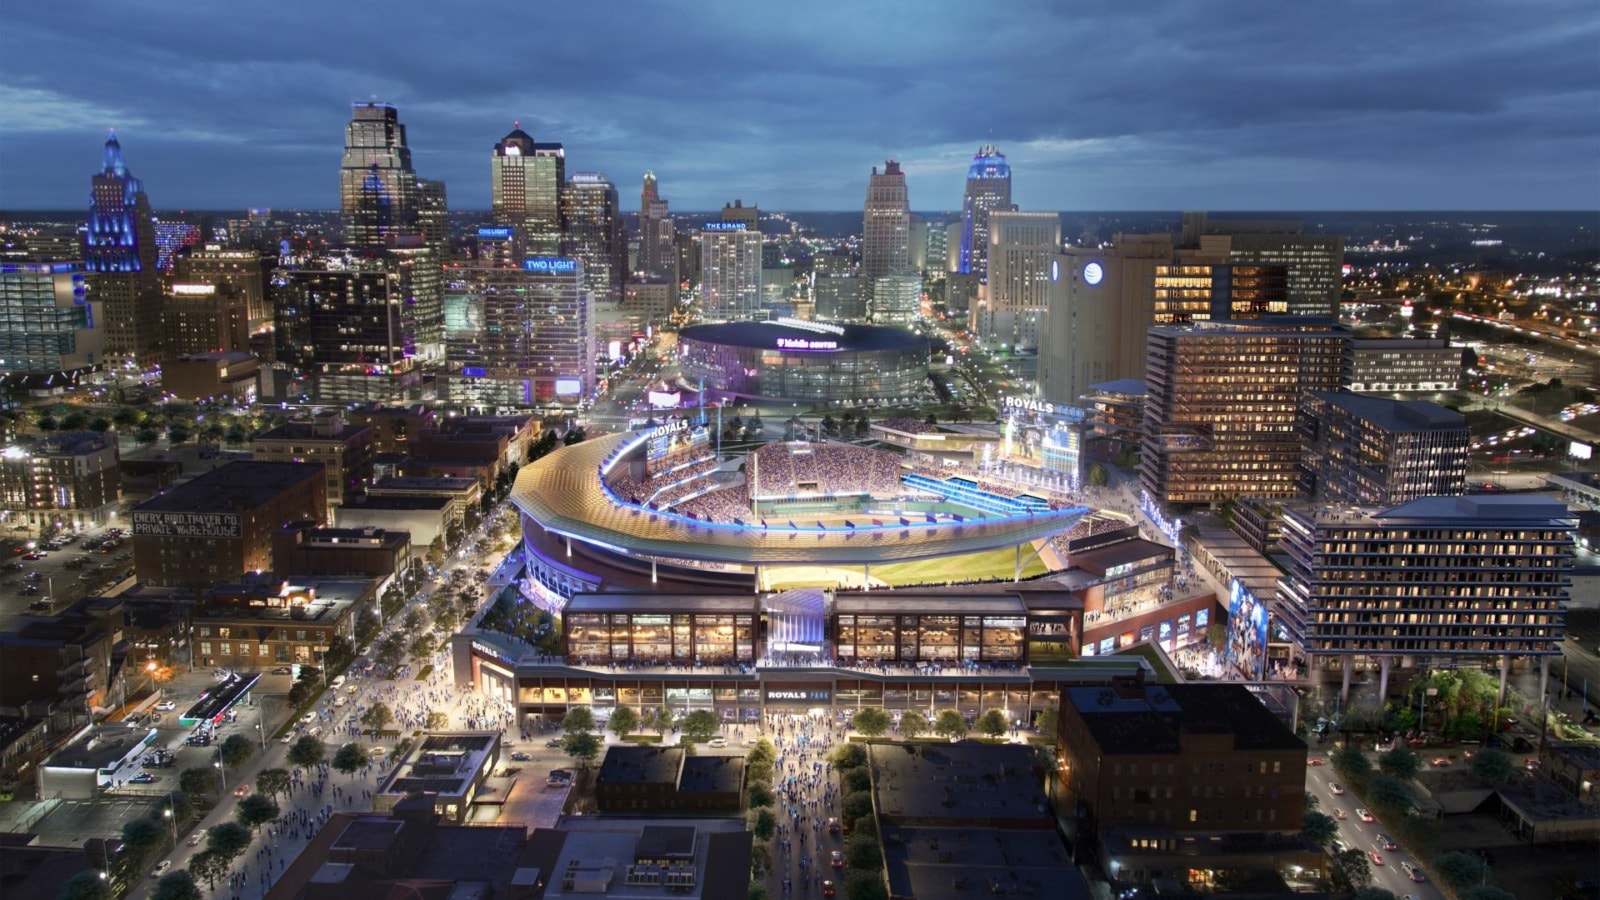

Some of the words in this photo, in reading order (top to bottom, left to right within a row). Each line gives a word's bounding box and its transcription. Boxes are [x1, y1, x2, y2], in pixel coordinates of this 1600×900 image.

[526, 260, 547, 269] TWO
[548, 260, 575, 269] LIGHT
[1006, 396, 1053, 413] ROYALS
[651, 419, 688, 439] ROYALS
[134, 512, 160, 523] EMERY
[165, 513, 185, 525] BIRD
[187, 514, 221, 526] THAYER
[135, 523, 172, 535] PRIVATE
[176, 525, 238, 537] WAREHOUSE
[472, 640, 498, 658] ROYALS
[768, 691, 807, 699] ROYALS
